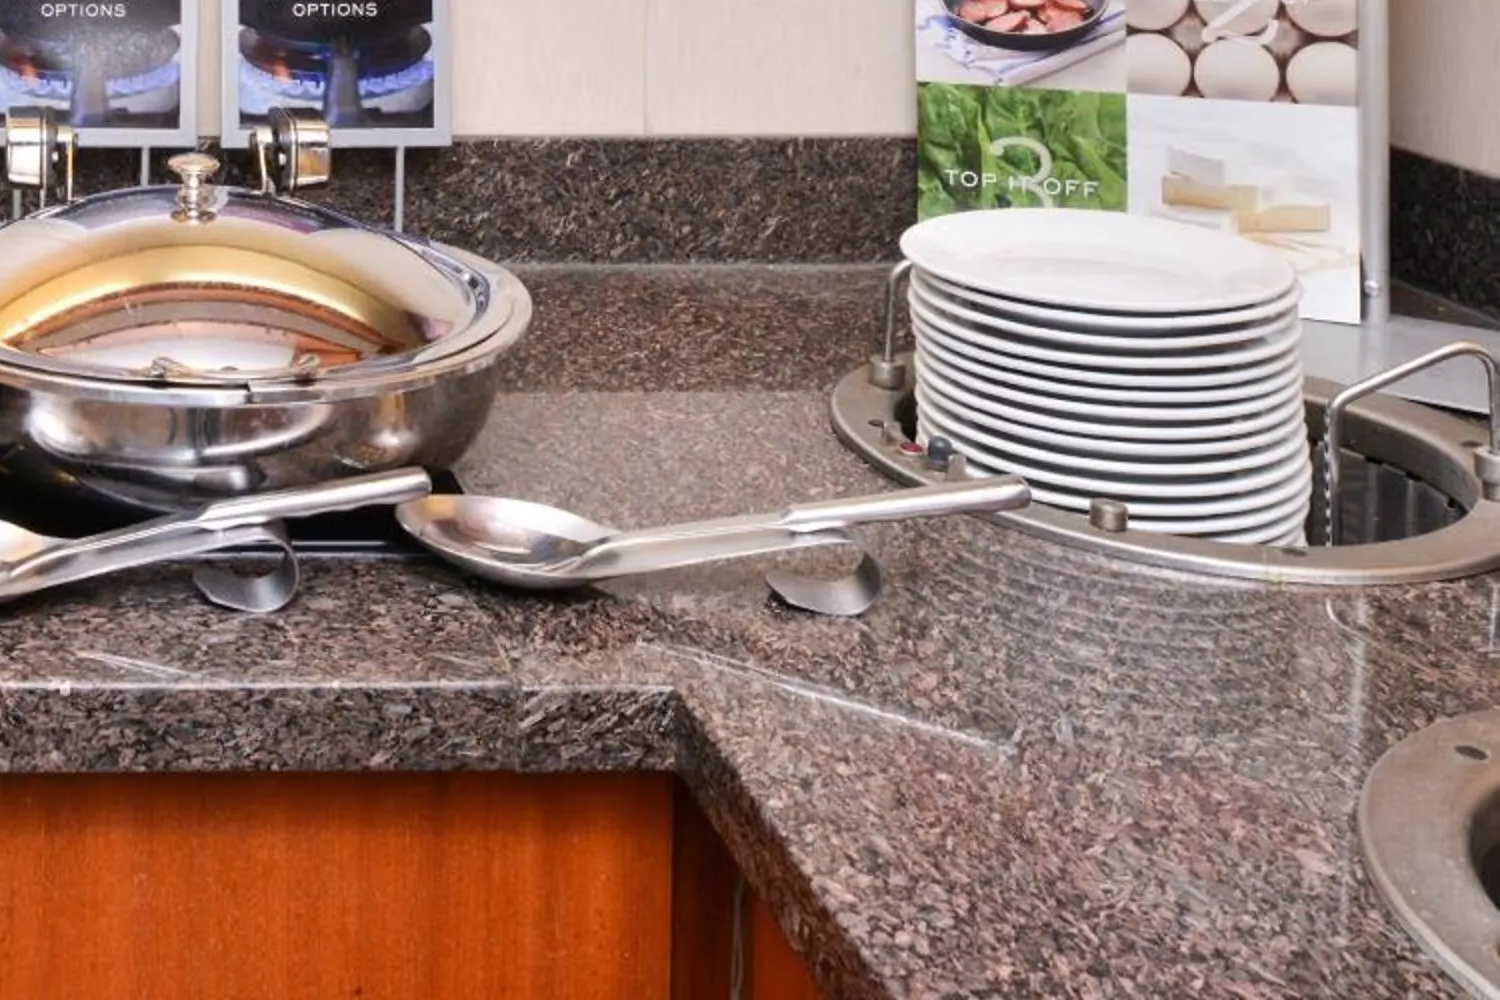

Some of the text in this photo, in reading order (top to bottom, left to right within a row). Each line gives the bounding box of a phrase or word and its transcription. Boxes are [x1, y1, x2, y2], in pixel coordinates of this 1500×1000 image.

[40, 3, 126, 18] OPTIONS
[292, 2, 378, 17] OPTIONS
[945, 169, 997, 188] TOP
[1043, 177, 1099, 198] OFF
